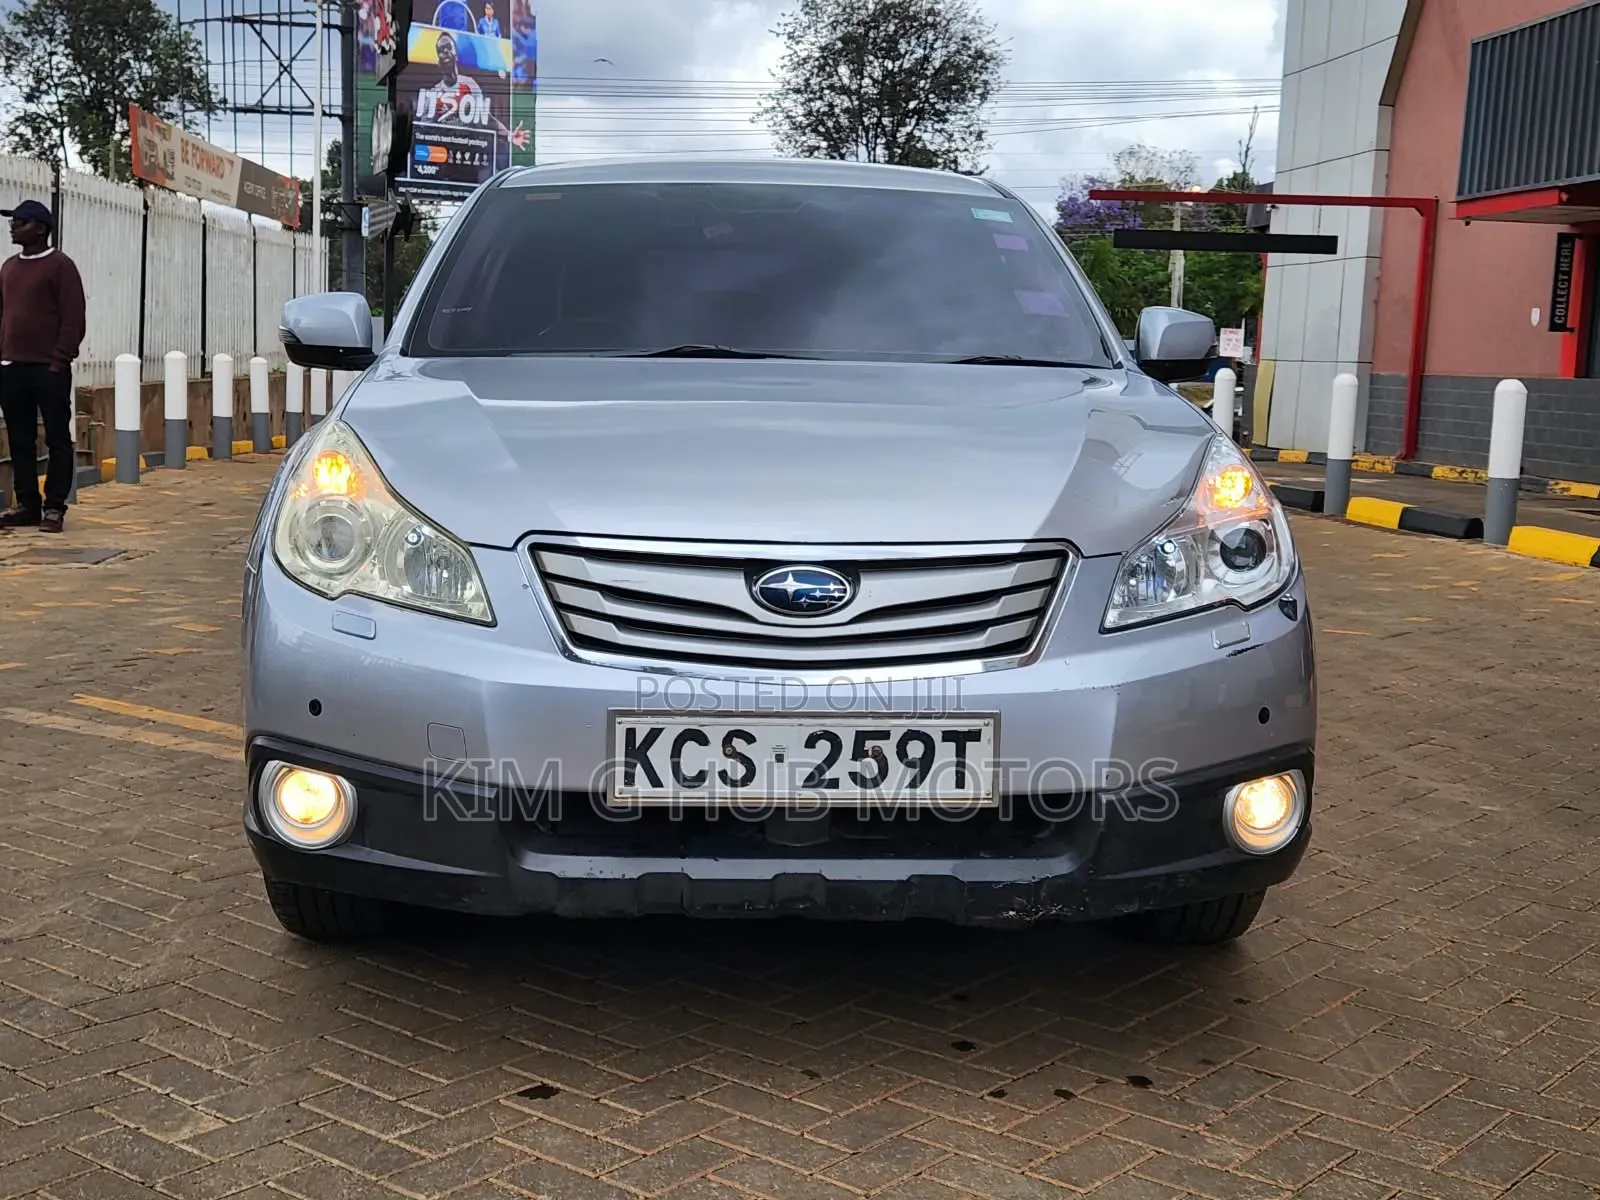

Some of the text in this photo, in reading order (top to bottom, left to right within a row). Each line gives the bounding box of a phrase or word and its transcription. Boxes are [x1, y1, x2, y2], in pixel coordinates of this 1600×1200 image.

[1554, 241, 1573, 324] COLLECT HERE
[623, 727, 982, 790] KCS 259T
